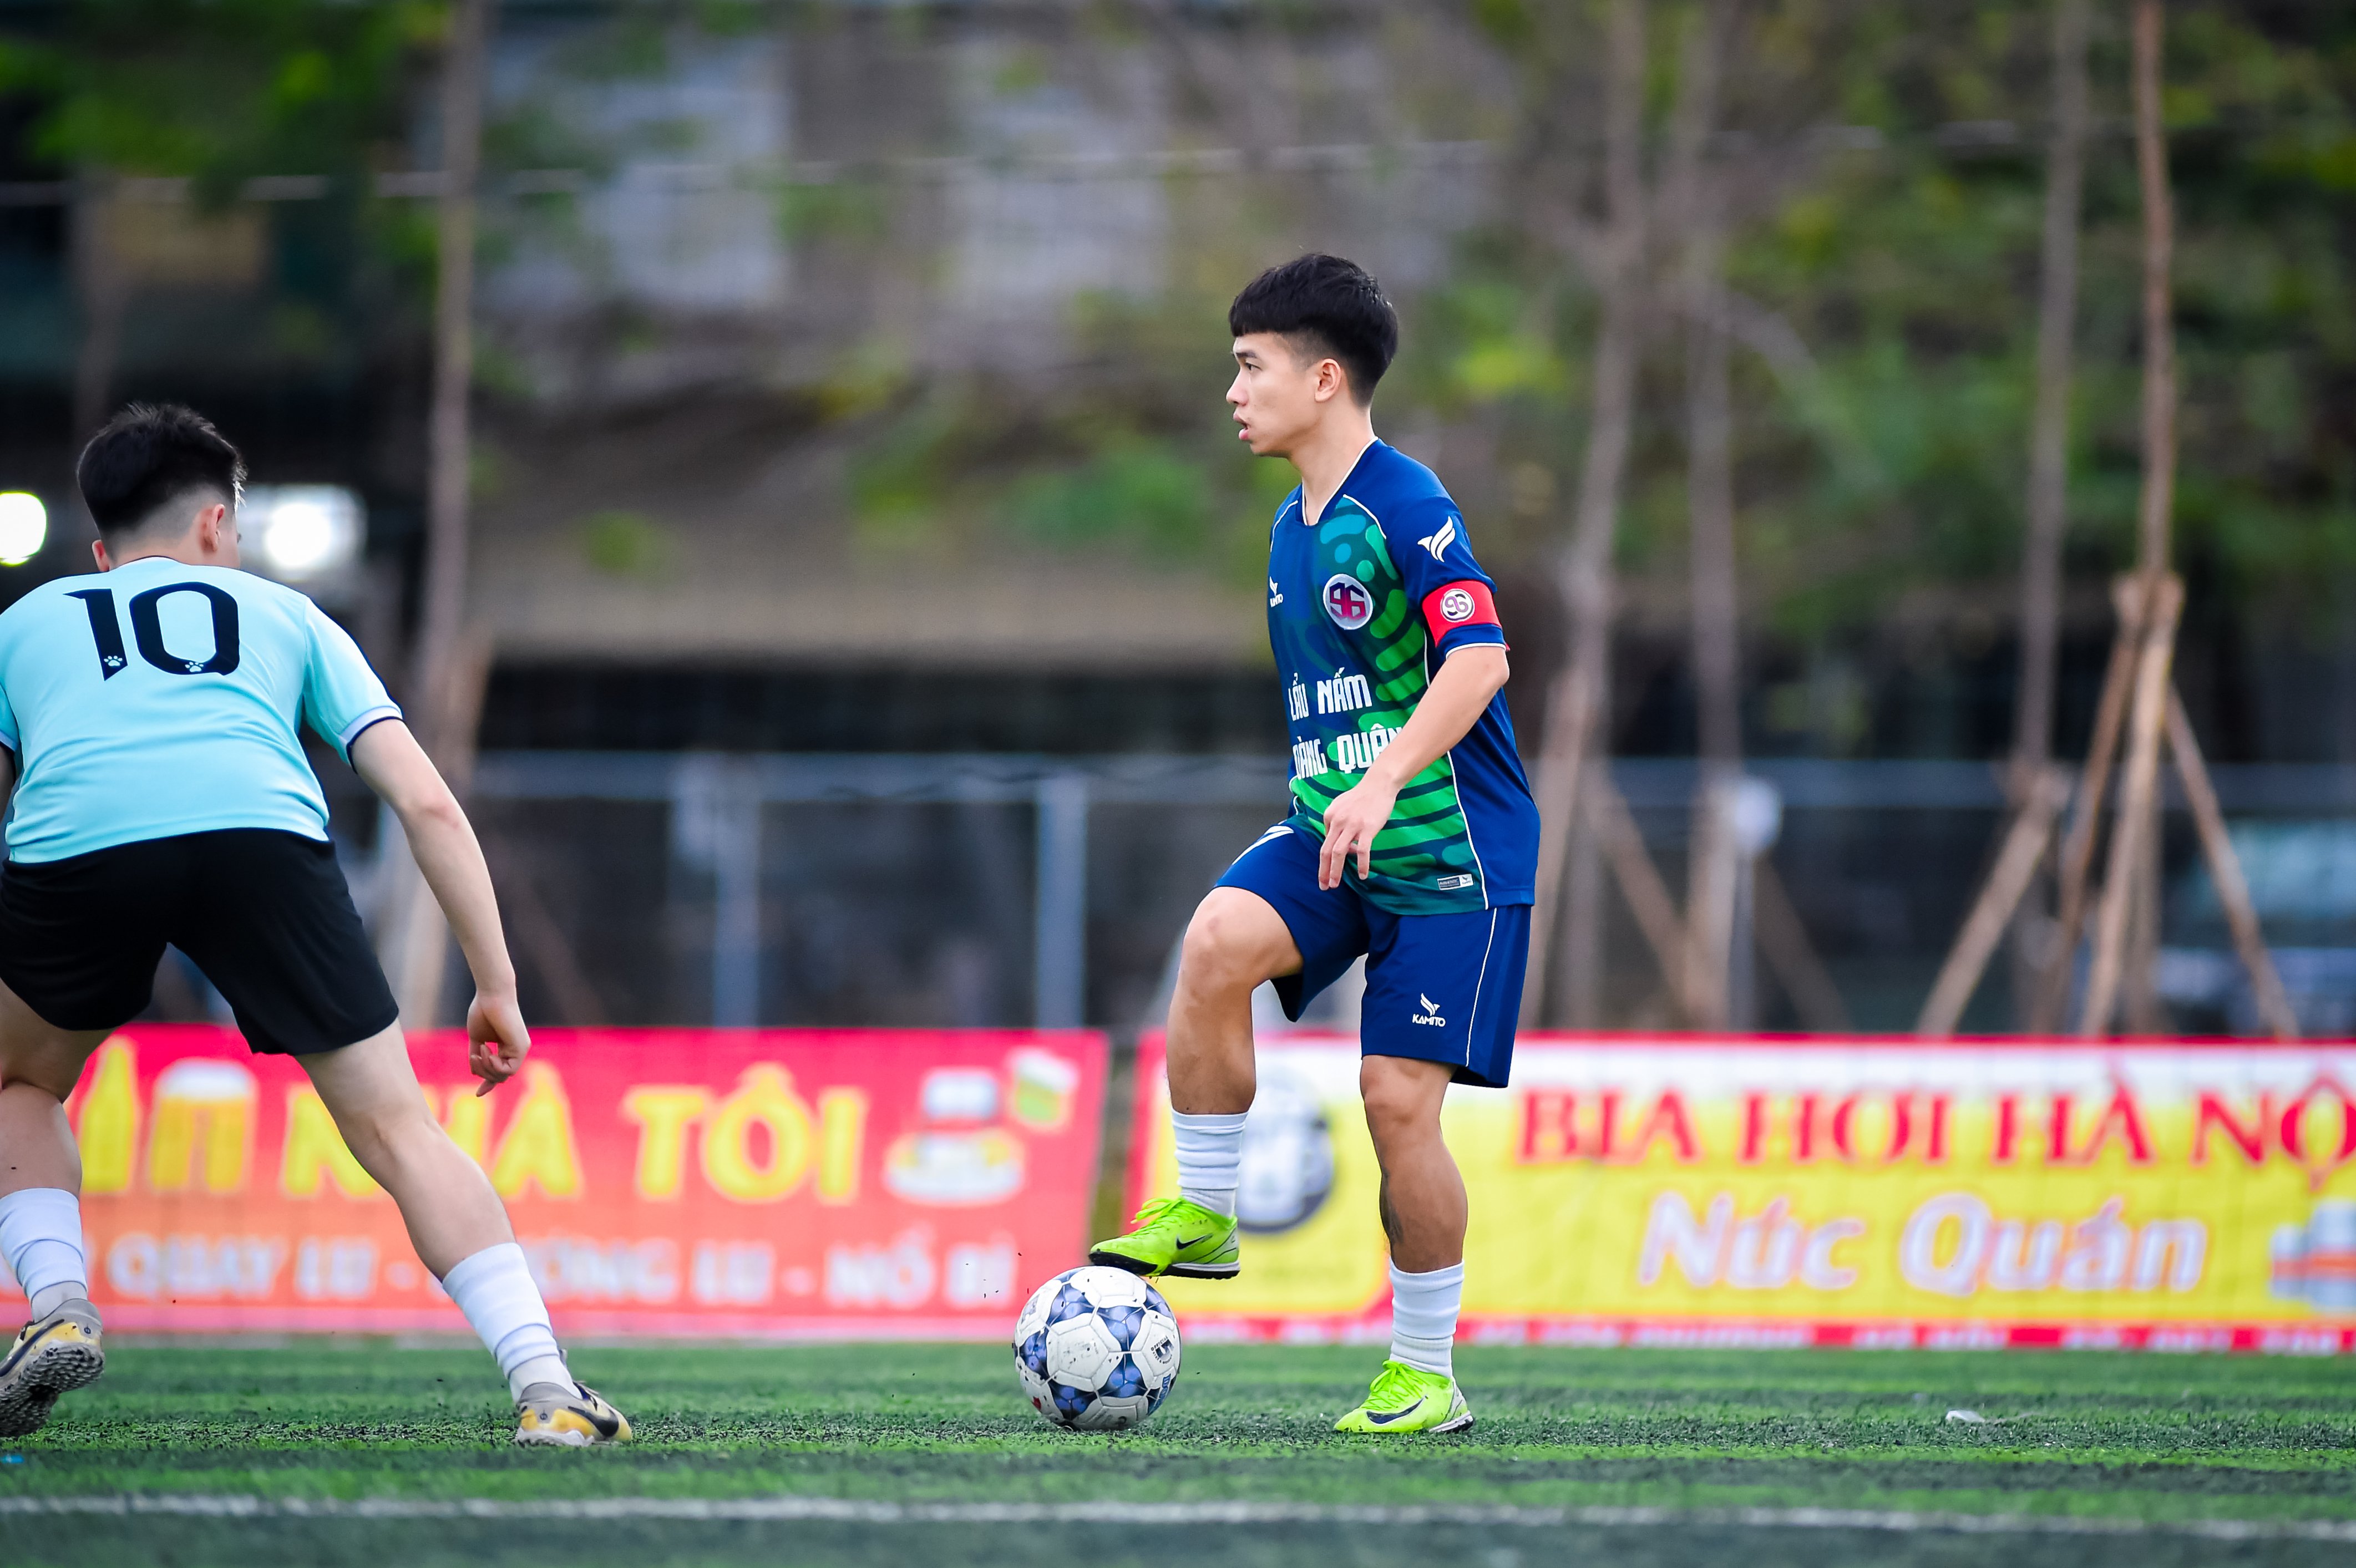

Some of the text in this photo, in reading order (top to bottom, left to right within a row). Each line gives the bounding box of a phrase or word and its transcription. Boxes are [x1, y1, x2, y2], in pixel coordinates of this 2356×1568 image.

[62, 581, 240, 682] 10
[1317, 667, 1372, 714] NẤM
[1412, 1013, 1446, 1027] KAMITO
[619, 1060, 870, 1205] TÔI
[1519, 1087, 1703, 1165] BIA
[1991, 1058, 2157, 1166] HÀ
[1899, 1191, 2208, 1298] Quán
